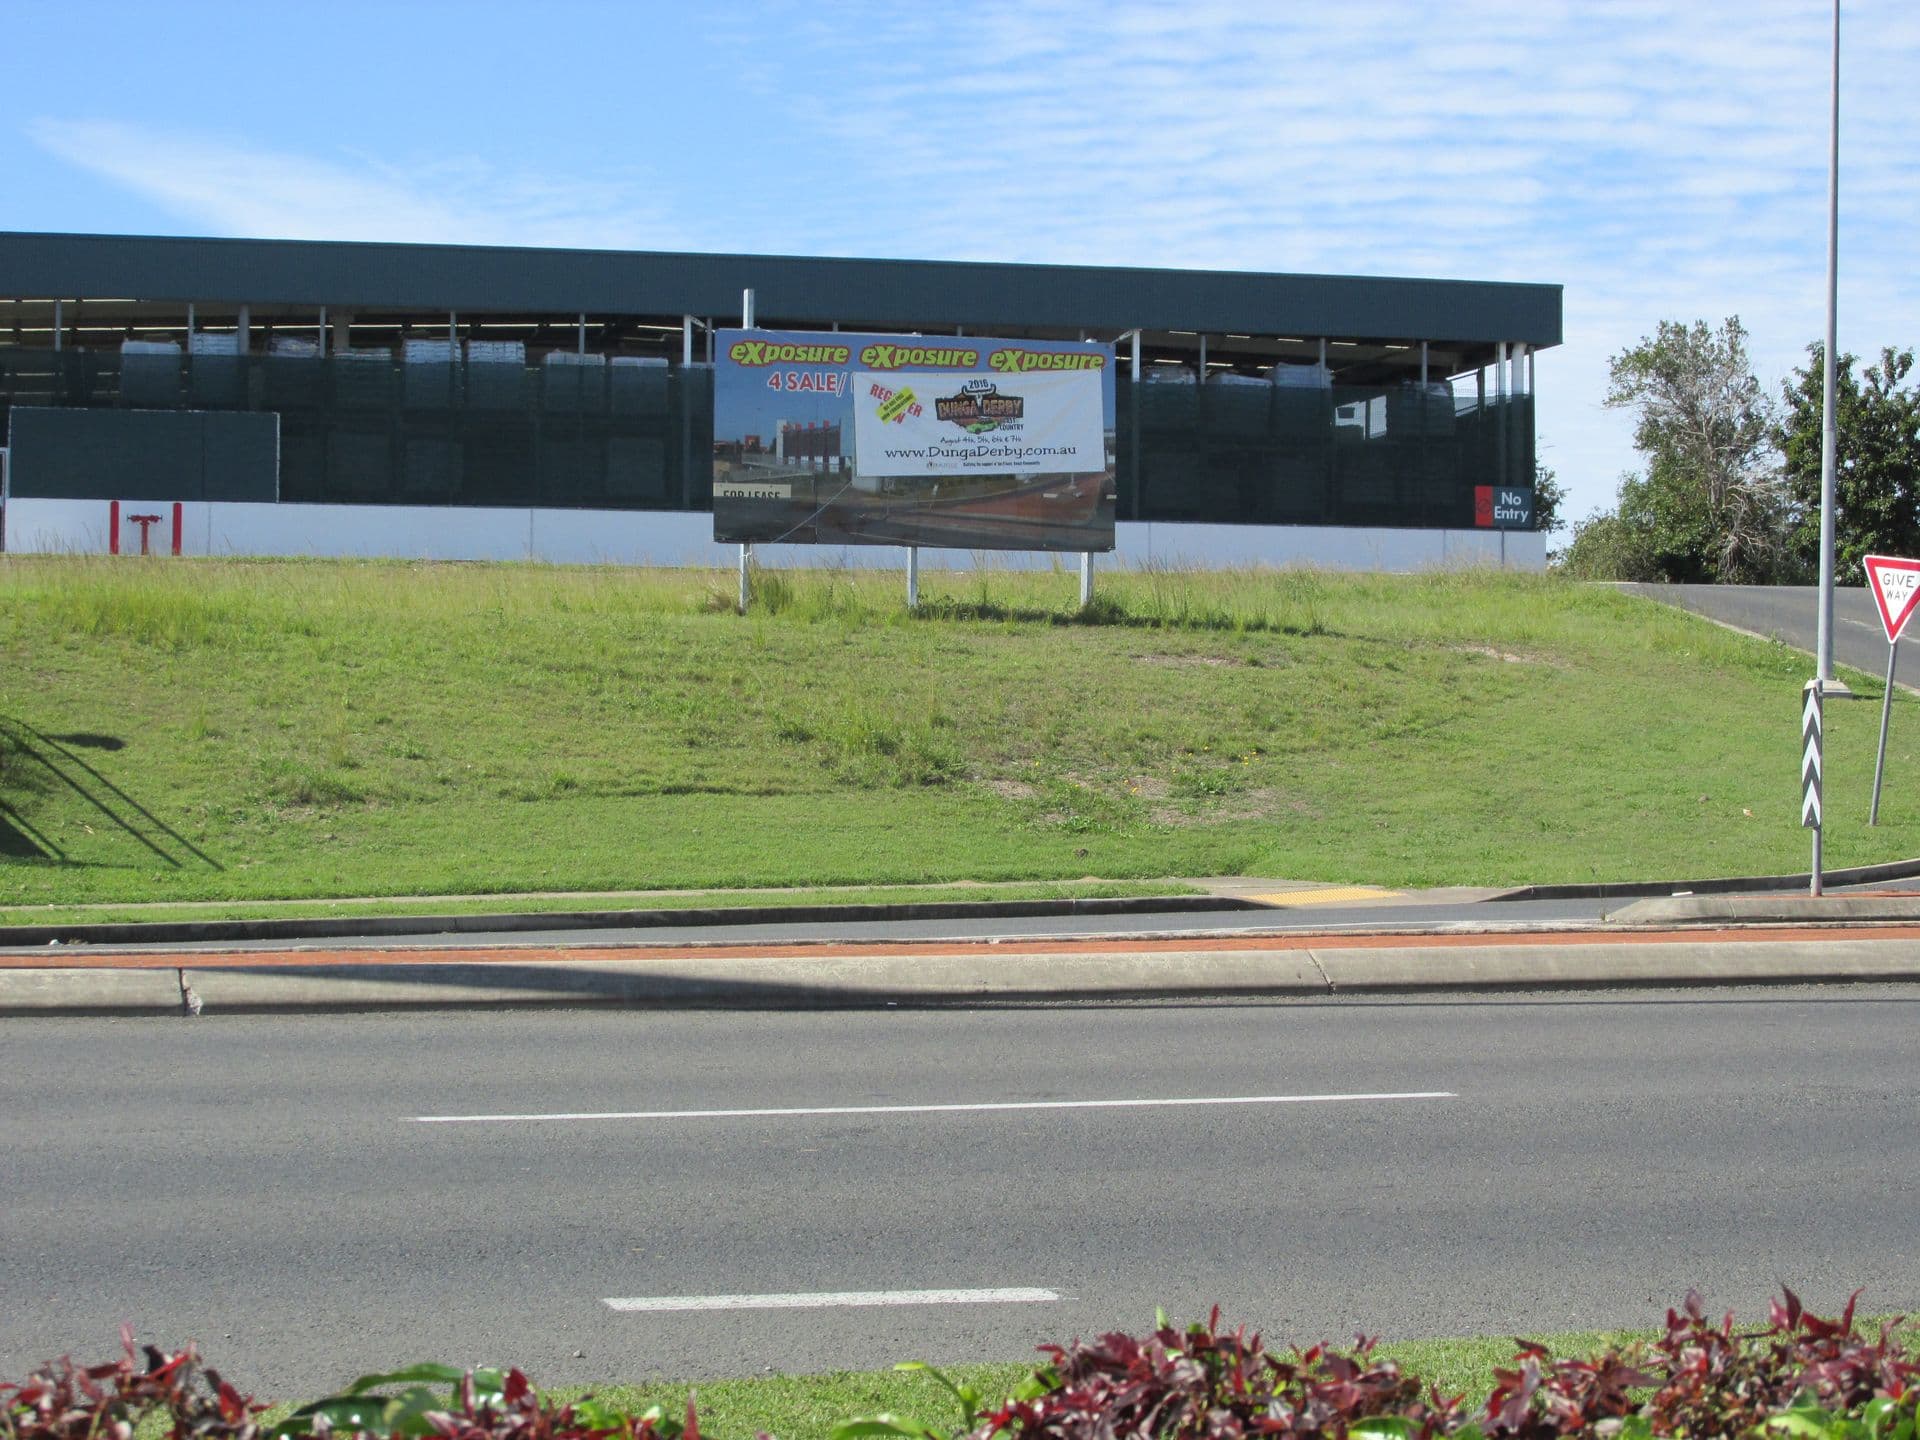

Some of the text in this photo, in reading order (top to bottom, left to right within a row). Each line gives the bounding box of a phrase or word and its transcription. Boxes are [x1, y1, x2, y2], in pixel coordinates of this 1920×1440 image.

[768, 373, 782, 391] 4
[968, 378, 989, 390] 2016
[937, 400, 979, 418] DUNGA
[982, 399, 1022, 417] DERBY
[885, 445, 1077, 460] www.DungaDerby.com.au
[1501, 492, 1522, 505] No
[1494, 506, 1529, 523] Entry
[1883, 573, 1915, 588] GIVE
[1886, 590, 1909, 602] WAY
